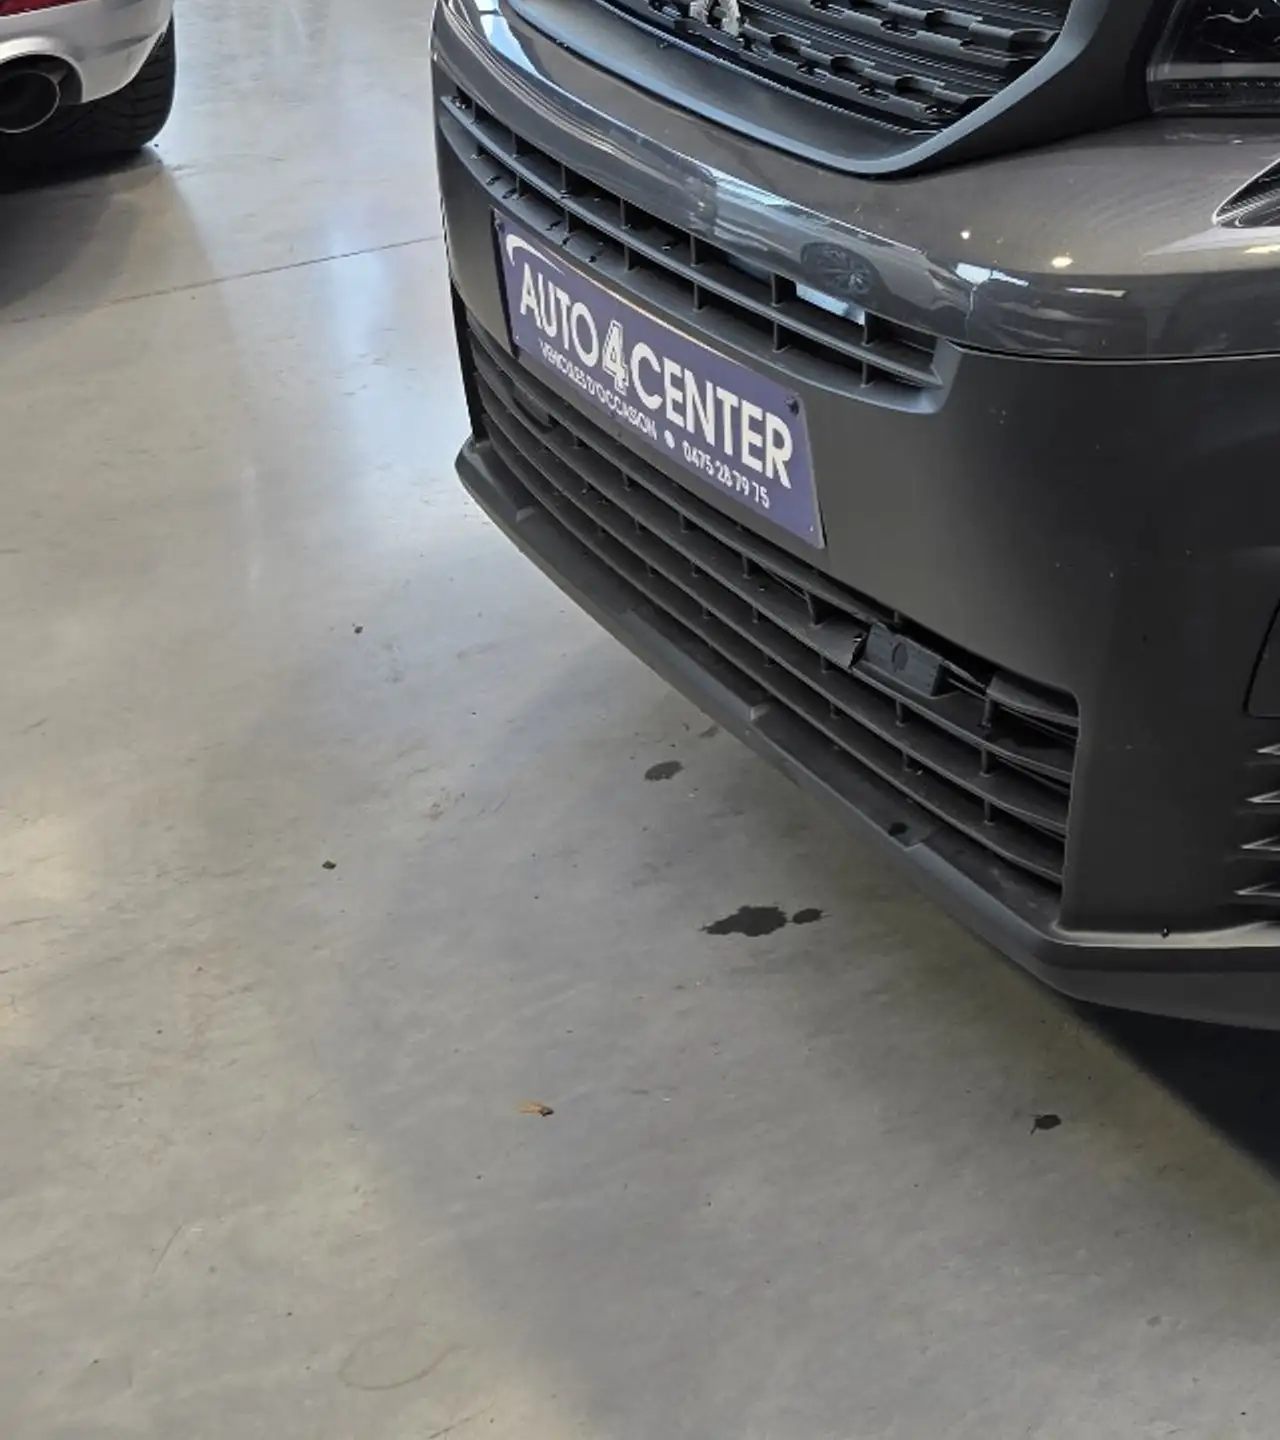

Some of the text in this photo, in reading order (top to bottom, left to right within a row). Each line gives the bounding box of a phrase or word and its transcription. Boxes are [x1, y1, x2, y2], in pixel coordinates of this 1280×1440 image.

[520, 262, 793, 489] AUTO 4 CENTER
[682, 440, 714, 476] 0475
[752, 481, 770, 509] 75
